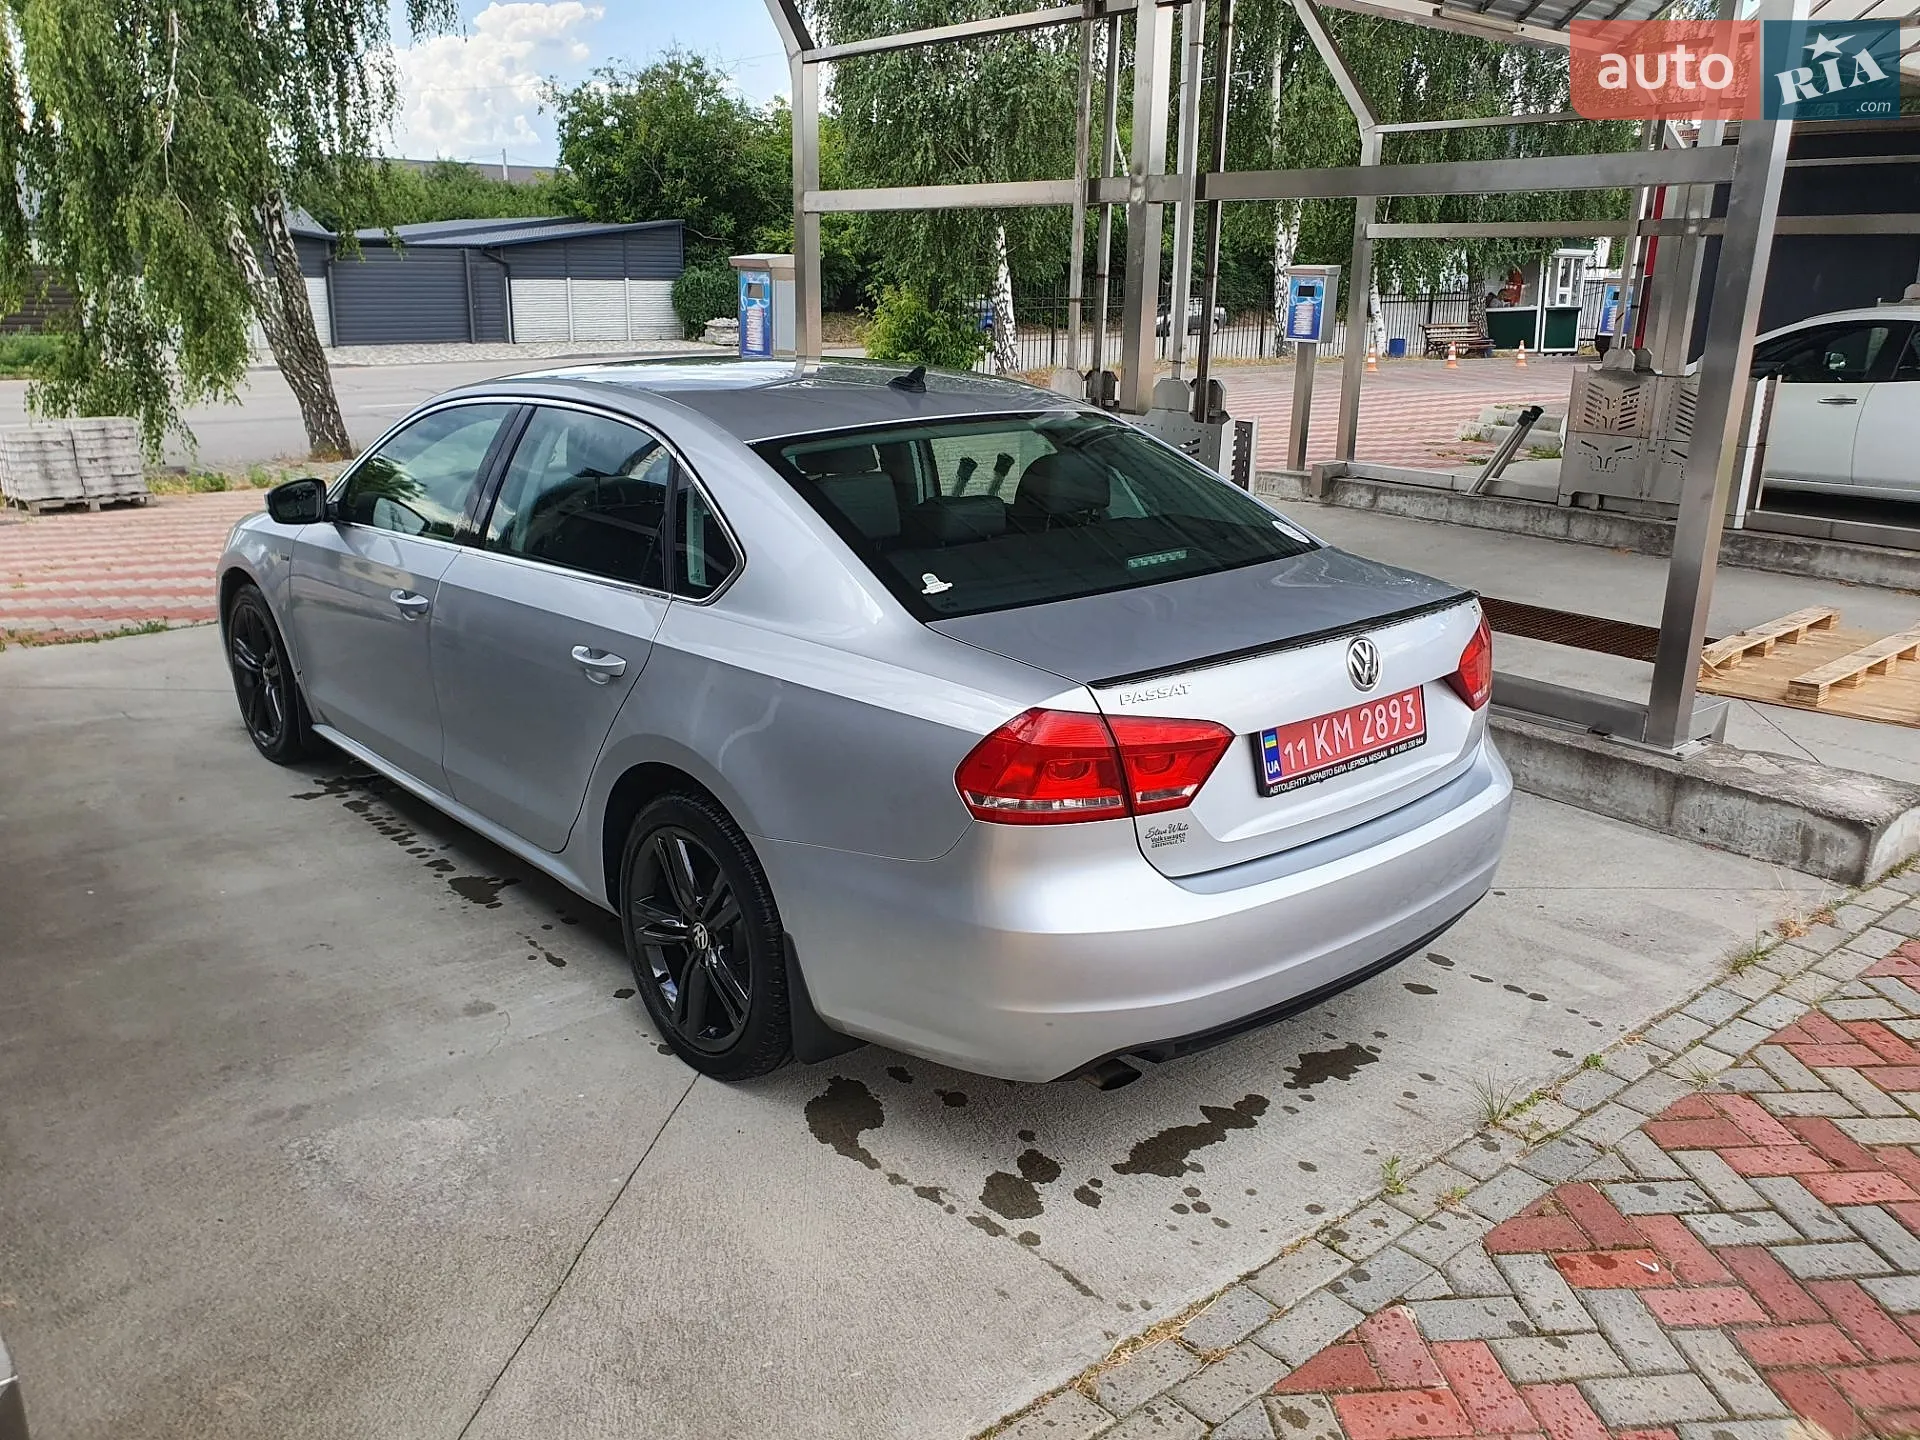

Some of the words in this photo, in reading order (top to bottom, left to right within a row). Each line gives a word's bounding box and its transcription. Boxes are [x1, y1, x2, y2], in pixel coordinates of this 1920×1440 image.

[1119, 683, 1192, 706] PASSAT
[1284, 738, 1309, 769] 11
[1312, 713, 1354, 760] KM
[1360, 694, 1415, 744] 2893
[1368, 750, 1388, 762] NISSAN
[1267, 760, 1281, 774] UA
